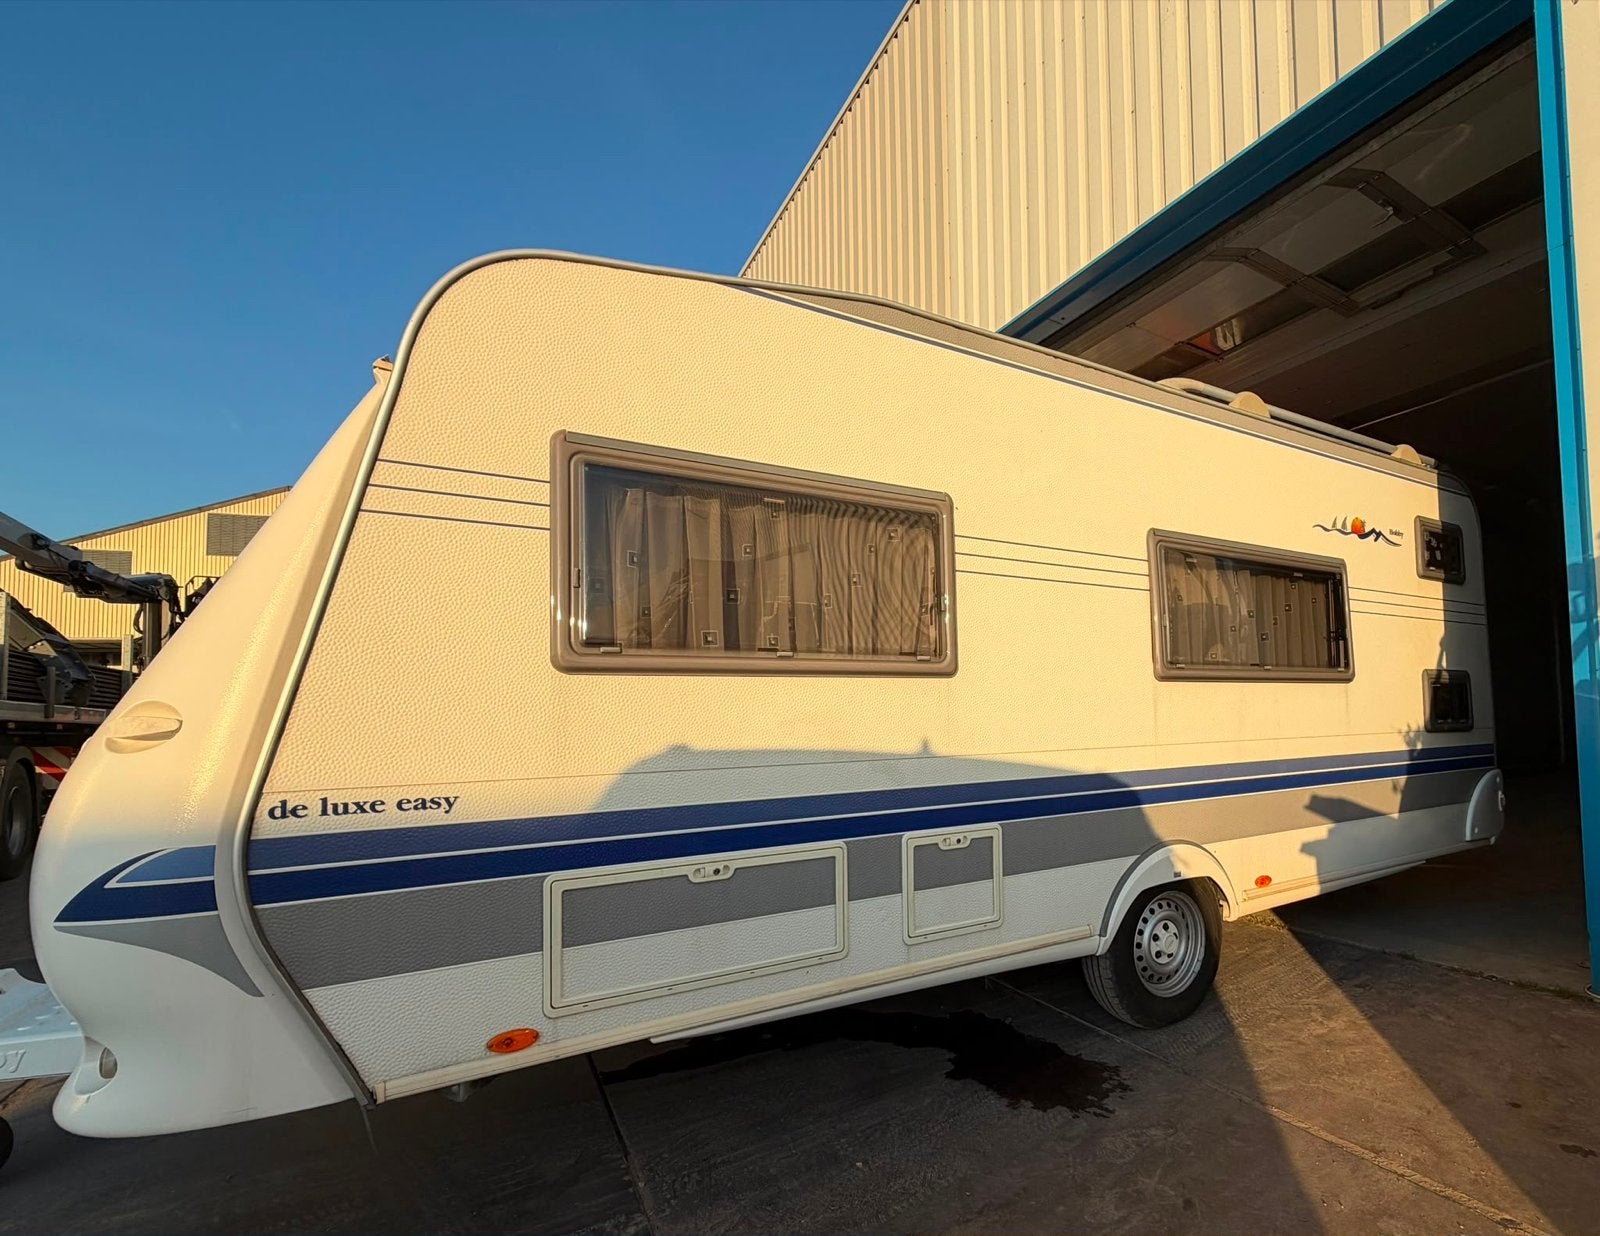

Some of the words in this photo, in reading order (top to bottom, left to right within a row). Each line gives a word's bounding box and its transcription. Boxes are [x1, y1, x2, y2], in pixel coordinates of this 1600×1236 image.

[268, 799, 308, 820] de
[318, 797, 386, 816] luxe
[396, 795, 460, 813] easy
